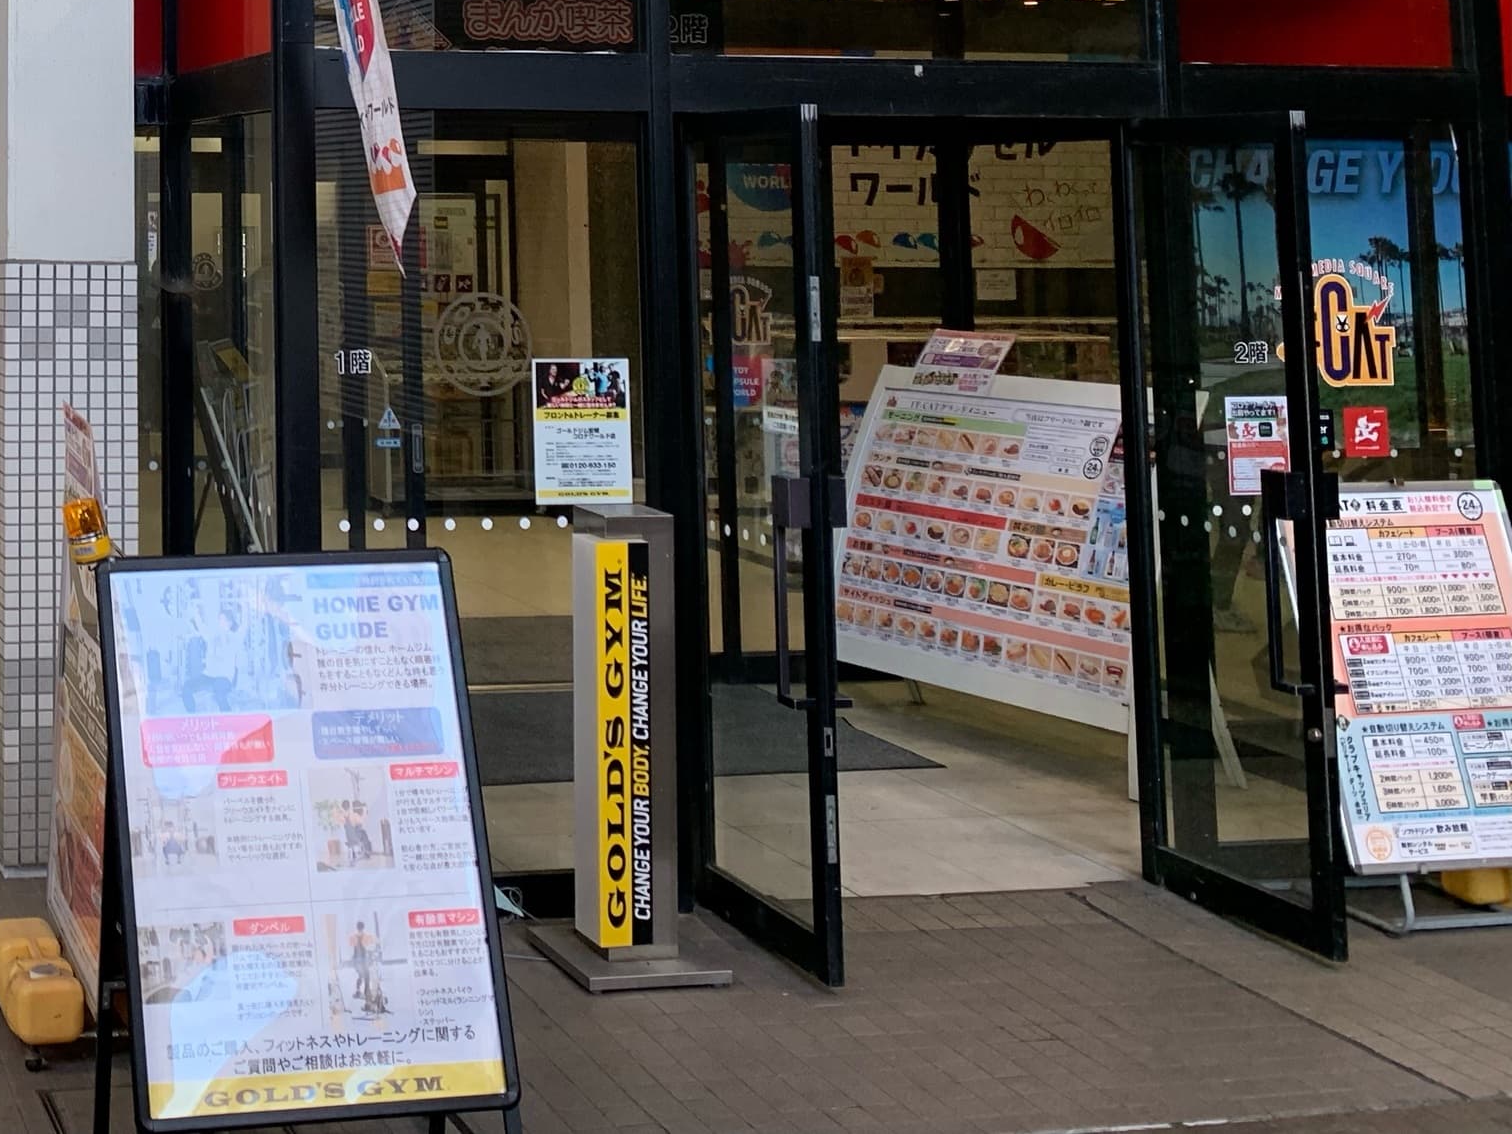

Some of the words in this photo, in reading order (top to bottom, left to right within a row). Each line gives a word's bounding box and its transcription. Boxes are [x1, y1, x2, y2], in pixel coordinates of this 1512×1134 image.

[742, 174, 791, 190] WORL
[334, 350, 372, 375] 1階
[1234, 341, 1268, 363] 2階
[1366, 500, 1404, 511] 料金表
[313, 596, 379, 614] HOME
[388, 594, 439, 612] GYM
[316, 621, 388, 640] GUIDE
[605, 568, 624, 698] GYM
[632, 620, 648, 666] YOUR
[632, 669, 648, 740] CHANGE
[220, 774, 283, 786] フリーウエイト
[395, 765, 453, 776] マルチマシン
[632, 744, 650, 797] BODY,
[604, 717, 626, 928] GOLD'S
[633, 799, 650, 847] YOUR
[634, 848, 650, 920] CHANGE
[249, 922, 290, 934] ダンベル
[415, 912, 475, 925] 有酸素マシン
[167, 1024, 476, 1060] 製品のご購入、フィットネスやトレーニングに関する
[234, 1052, 413, 1075] ご質問やご相談はお気軽に。
[204, 1080, 345, 1108] GOLD'S
[357, 1075, 444, 1096] GYM
